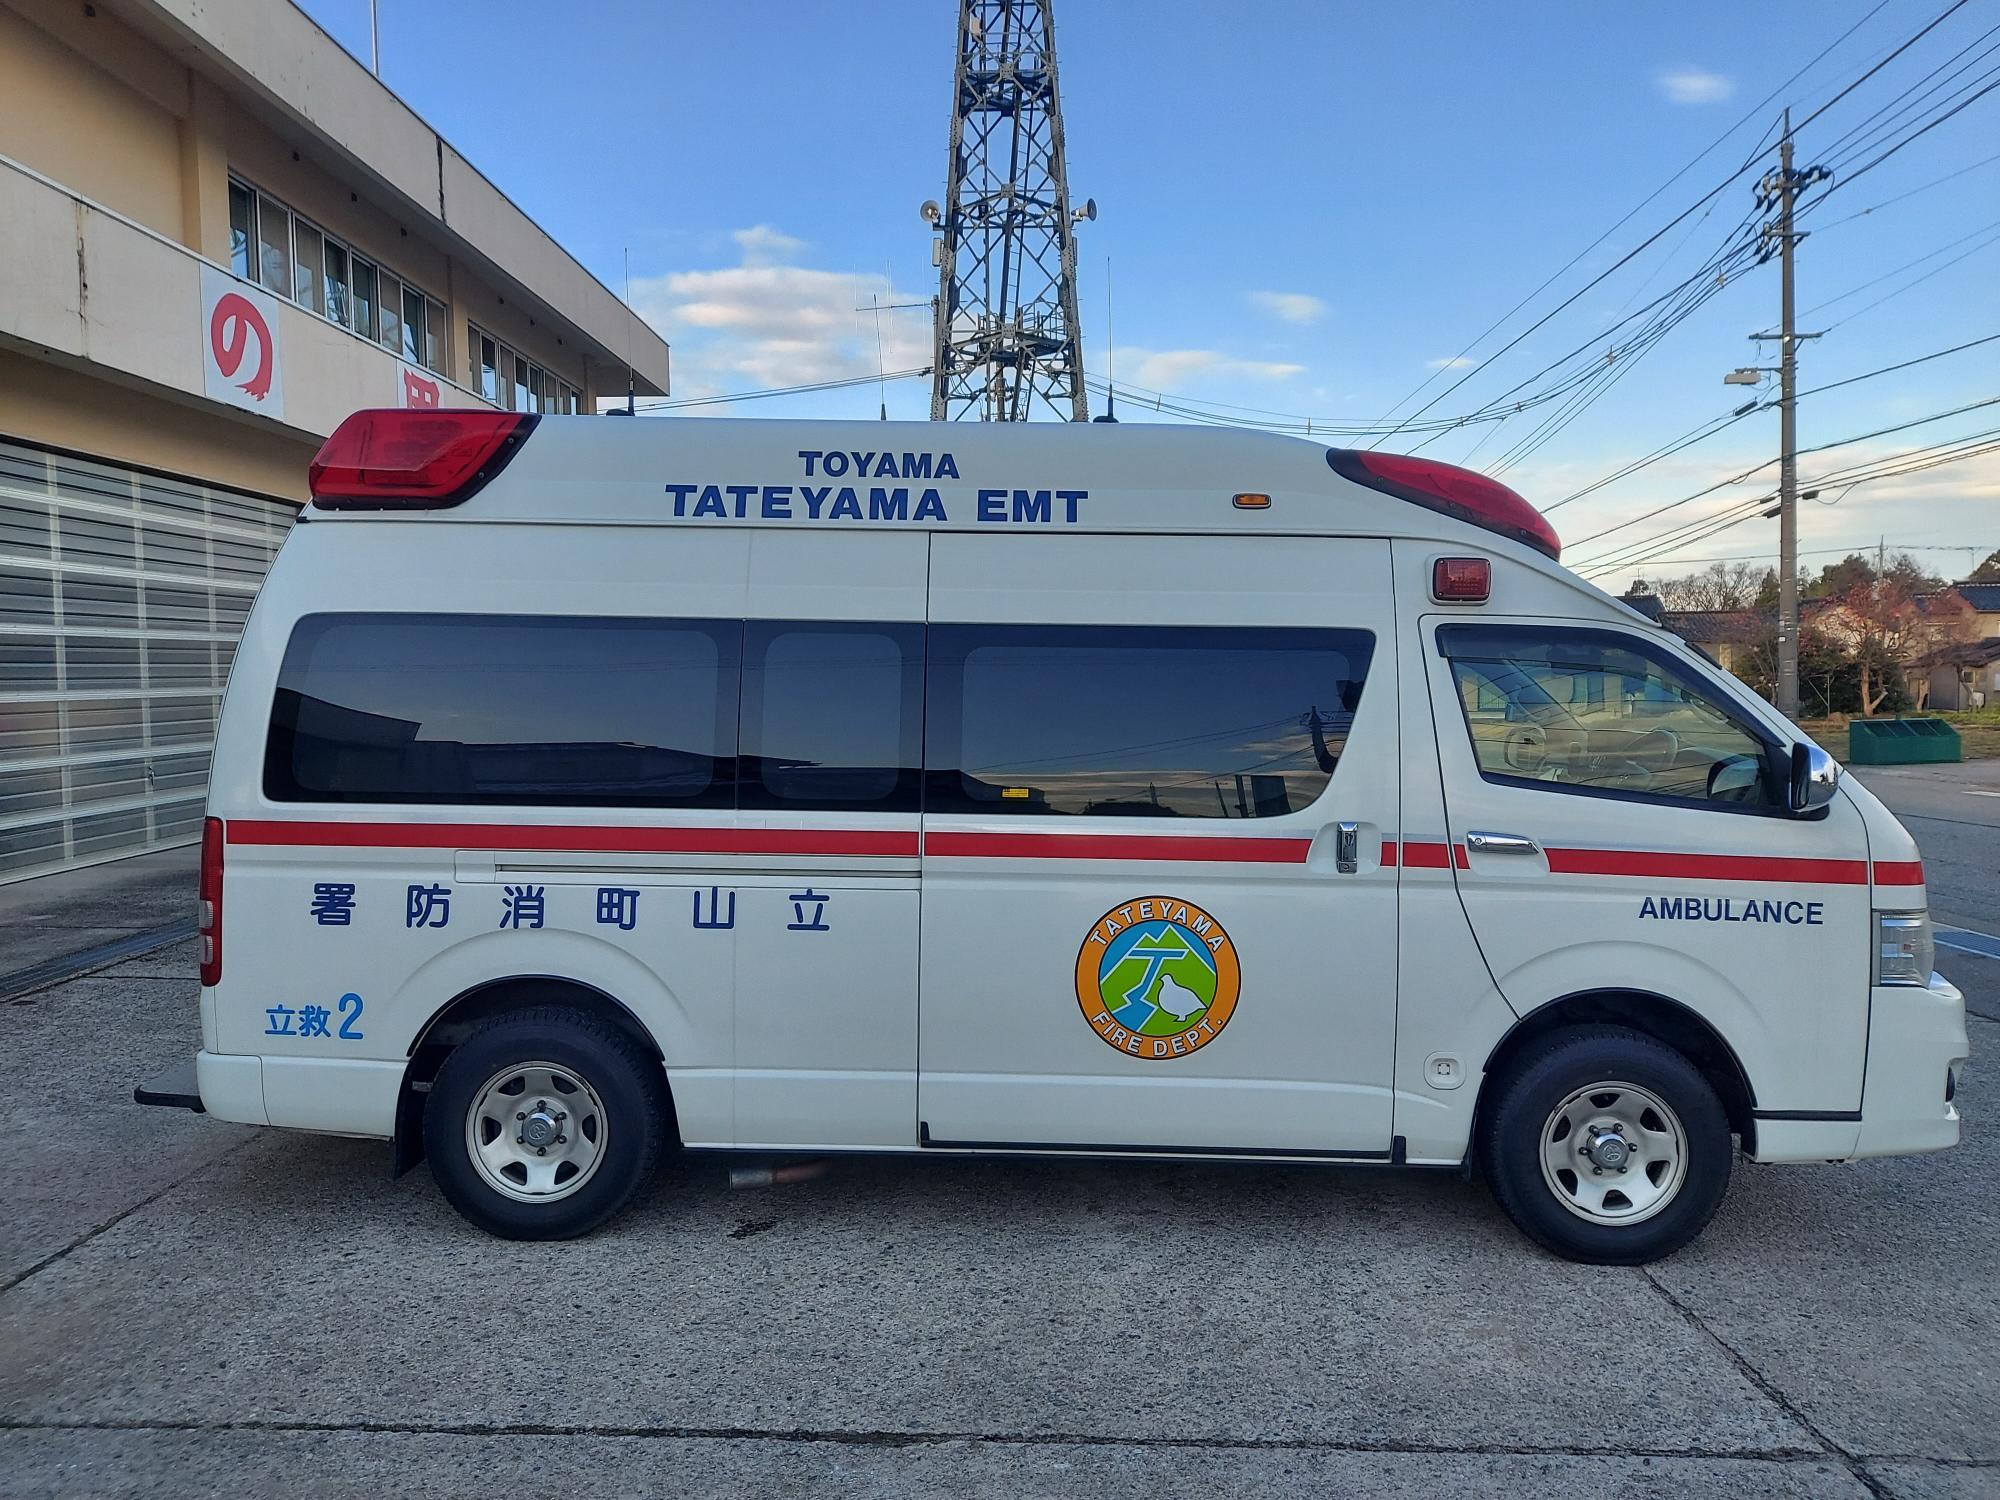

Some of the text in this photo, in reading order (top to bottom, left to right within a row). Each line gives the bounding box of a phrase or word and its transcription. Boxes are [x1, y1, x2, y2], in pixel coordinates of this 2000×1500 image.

[210, 292, 273, 402] の
[798, 450, 961, 480] TOYAMA
[665, 484, 1090, 524] TATEYAMA EMT
[1090, 900, 1226, 953] TATEYAMA
[1638, 896, 1825, 926] AMBULANCE
[1091, 1009, 1225, 1058] FIRE DEPT.
